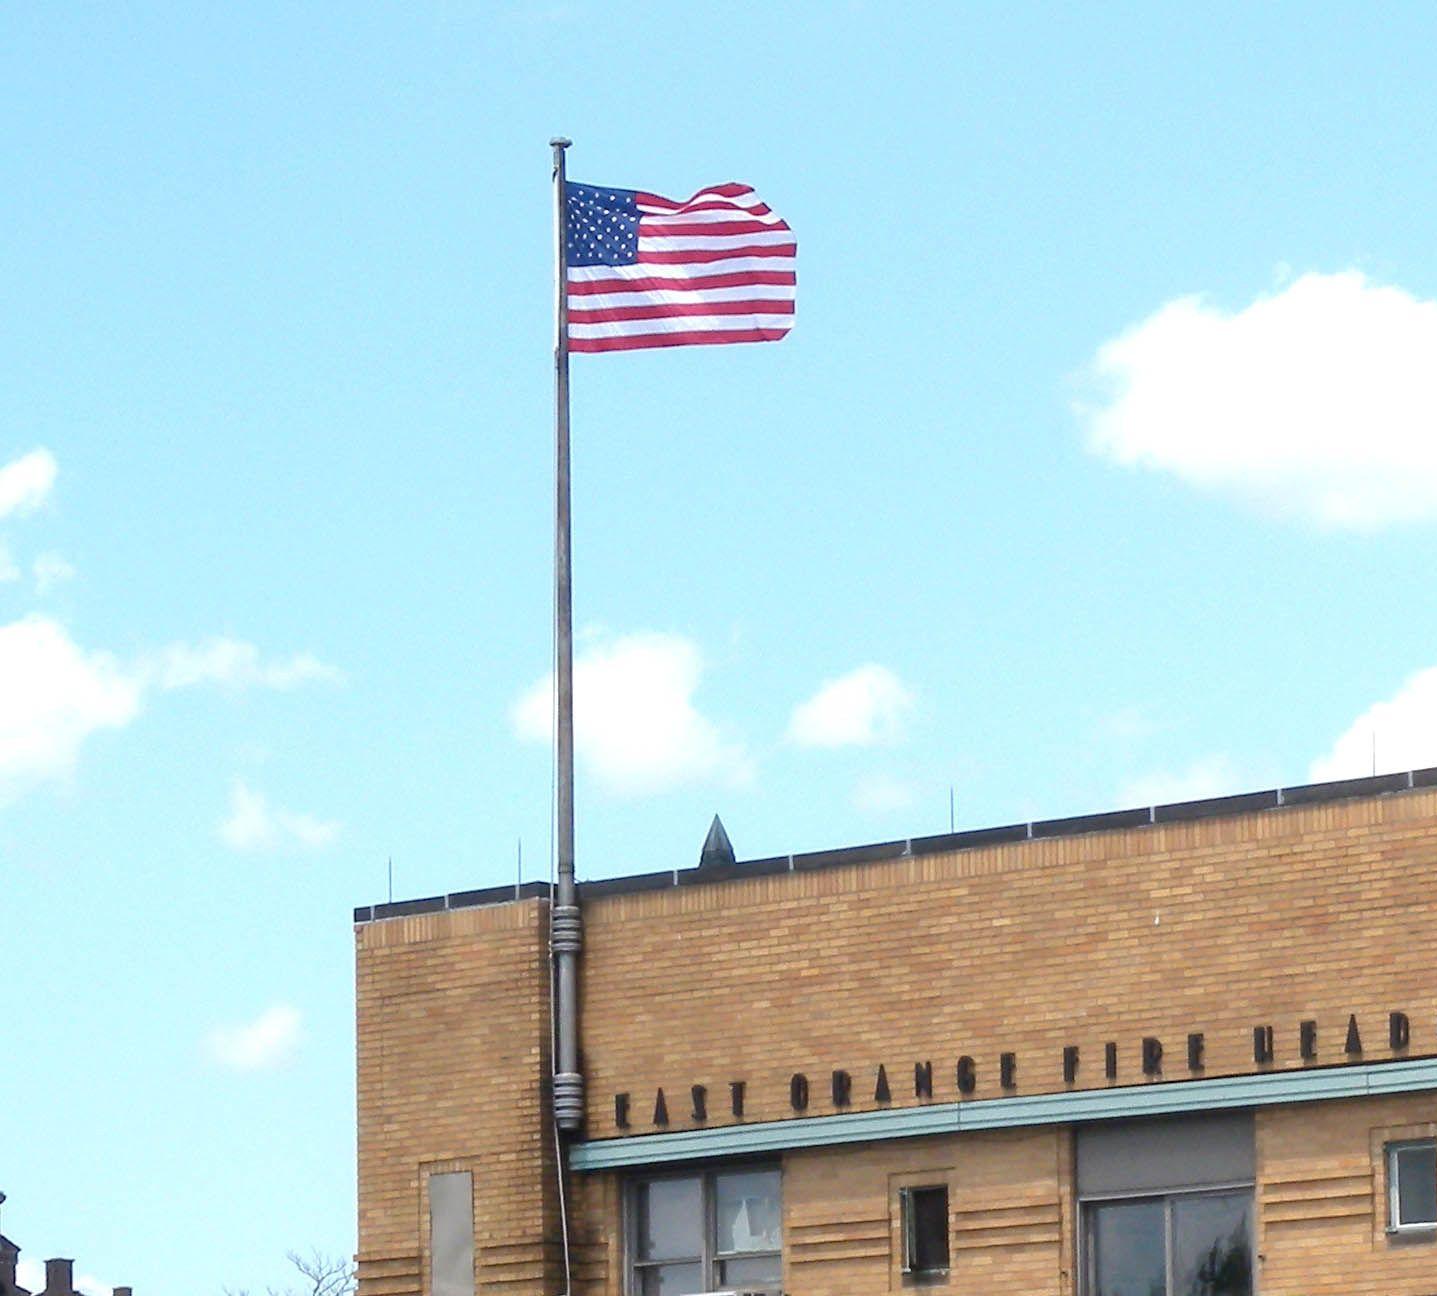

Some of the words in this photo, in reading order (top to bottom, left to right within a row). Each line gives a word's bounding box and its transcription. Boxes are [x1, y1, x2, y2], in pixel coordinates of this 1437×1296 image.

[614, 1080, 747, 1129] EAST
[790, 1052, 1017, 1111] ORANGE
[1063, 1033, 1206, 1083] FIRE
